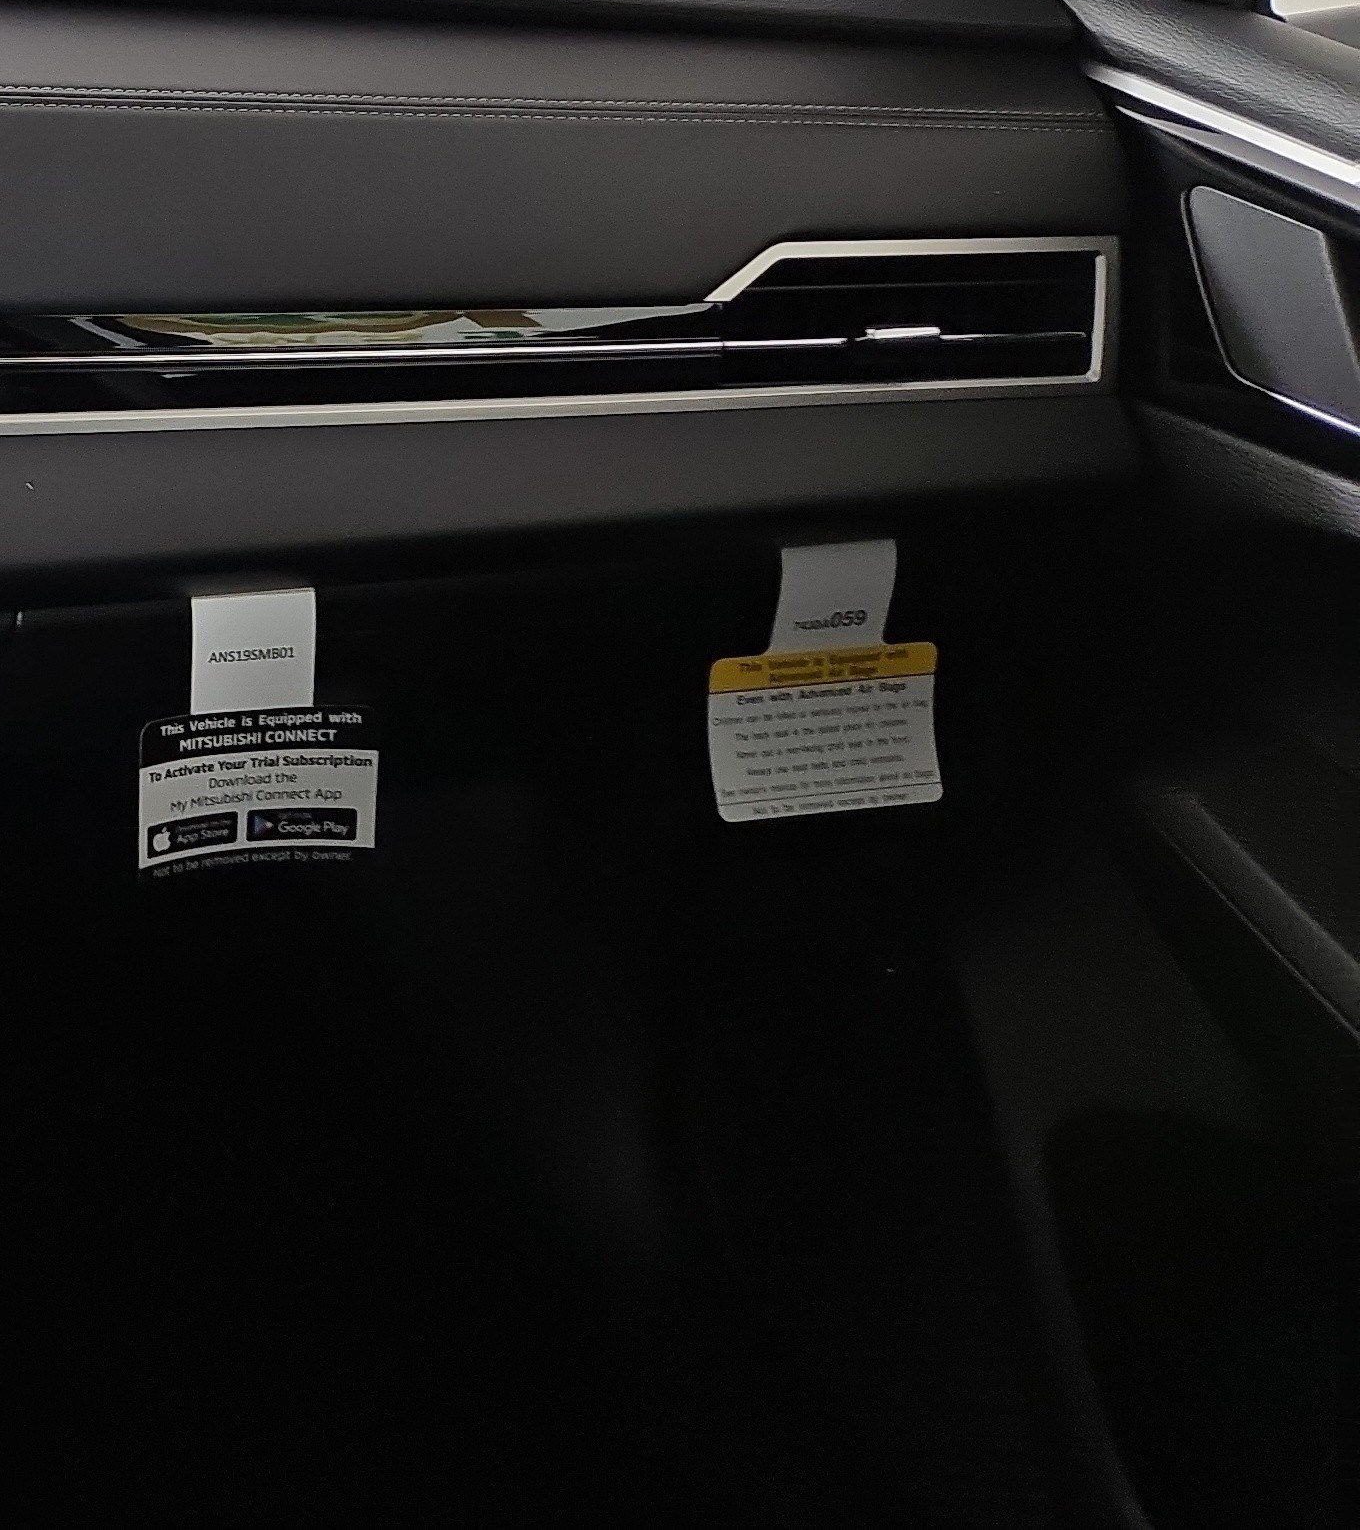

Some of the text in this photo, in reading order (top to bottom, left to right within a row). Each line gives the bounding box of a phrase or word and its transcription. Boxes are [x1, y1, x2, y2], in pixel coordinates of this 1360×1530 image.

[159, 711, 362, 736] This Vehicle is Equipped with
[179, 729, 337, 752] MITSUBISHI CONNECT
[149, 754, 373, 784] To Activate Your Trial Subscription
[208, 771, 298, 790] Download the
[170, 787, 343, 814] My Mitsubishi Connect App
[277, 820, 350, 836] Google Play
[201, 852, 250, 868] removed
[251, 850, 291, 863] except
[294, 850, 308, 861] by
